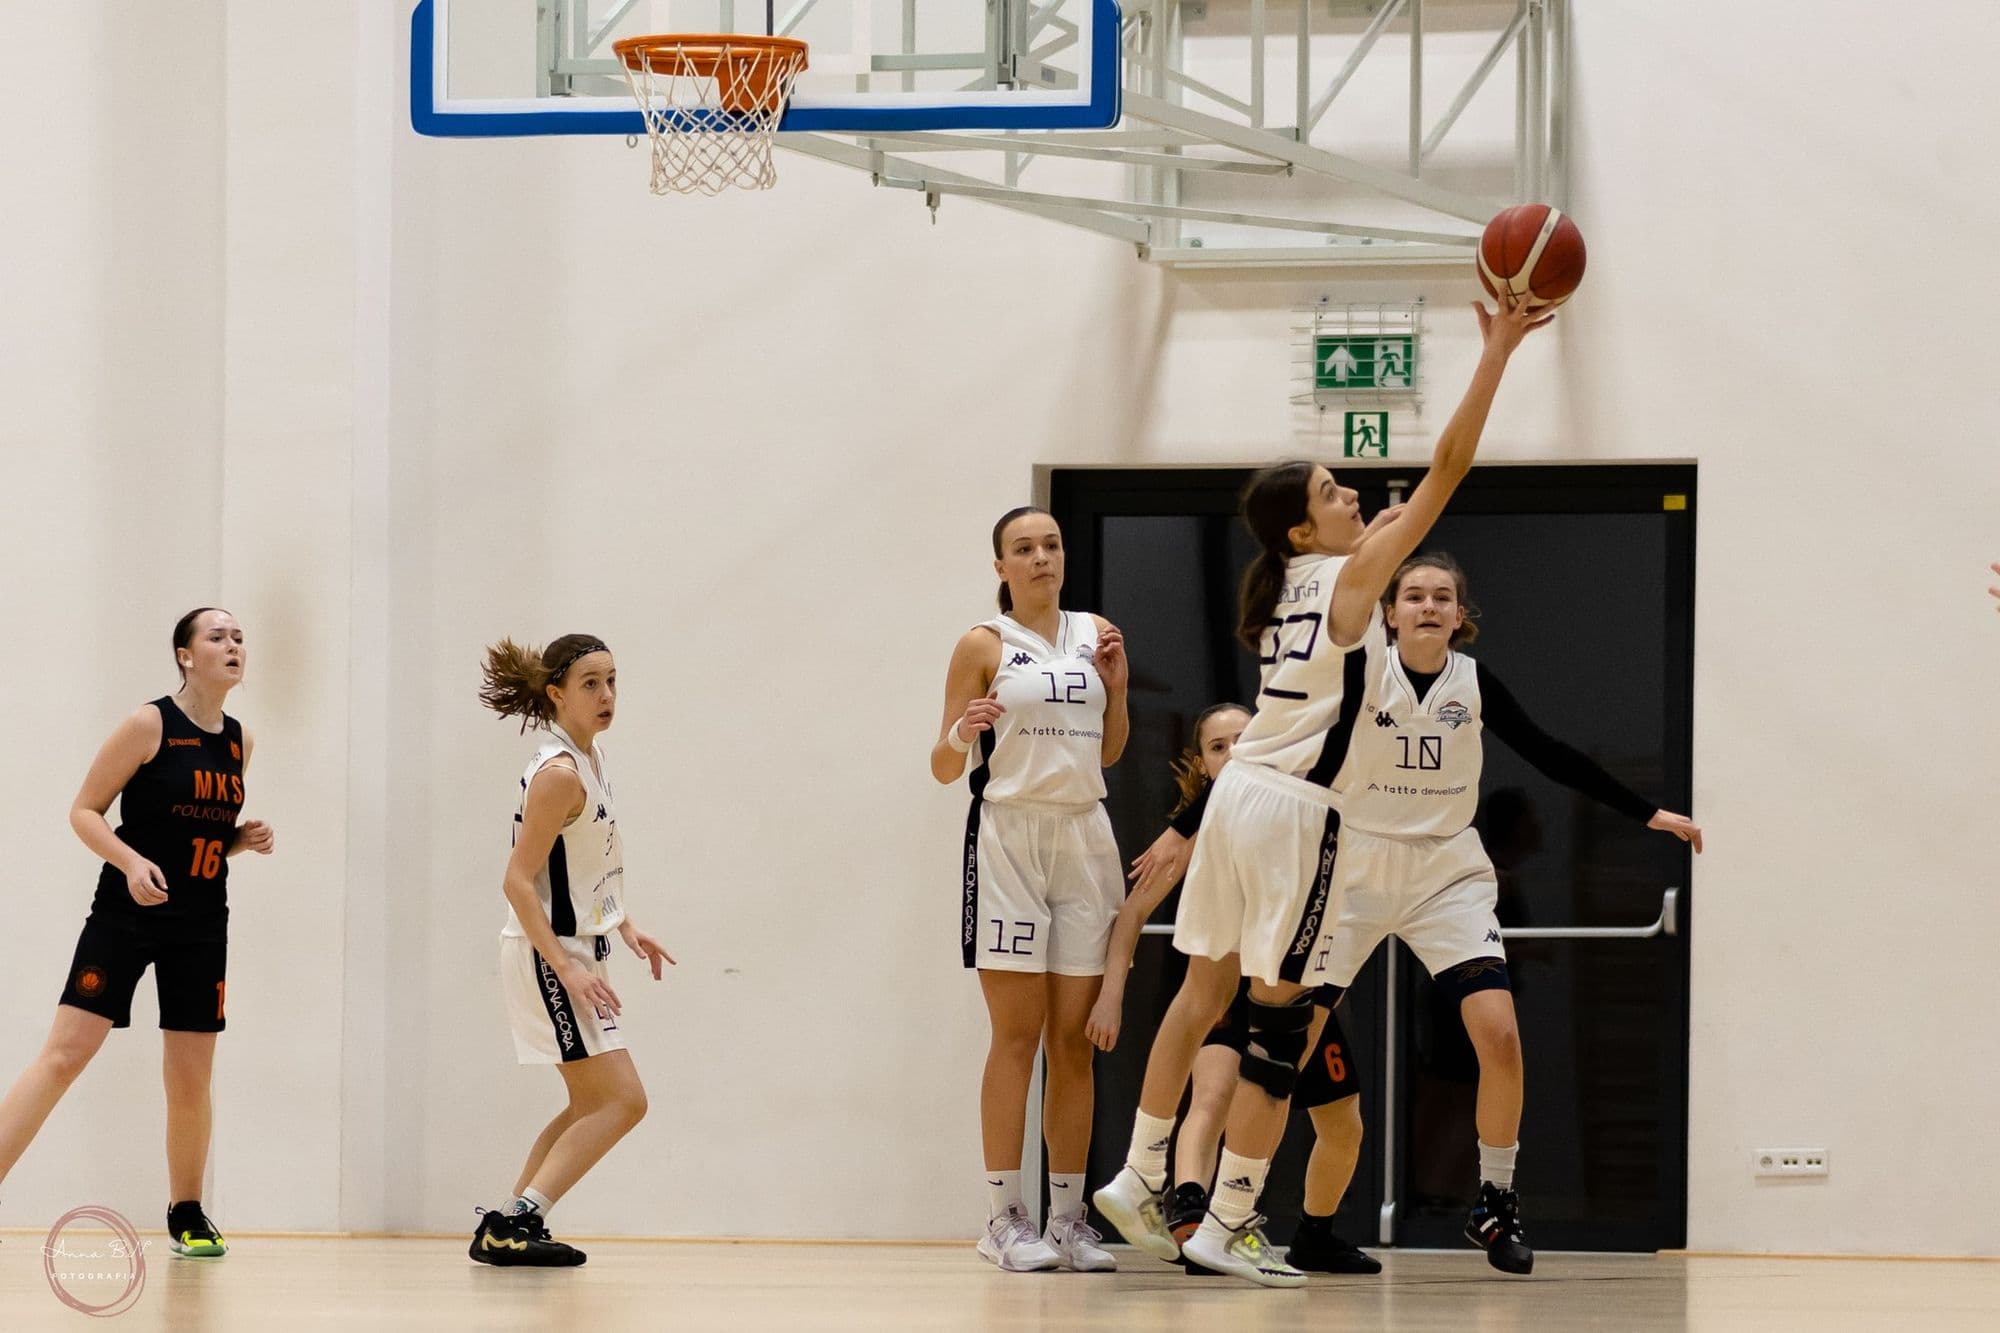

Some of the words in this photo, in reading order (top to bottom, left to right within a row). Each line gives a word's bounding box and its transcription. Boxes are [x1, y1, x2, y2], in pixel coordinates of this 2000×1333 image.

[1041, 672, 1087, 704] 12
[1033, 727, 1064, 736] fatto
[1395, 736, 1442, 770] 10
[194, 769, 243, 804] MKS
[190, 838, 222, 879] 16
[988, 919, 1035, 955] 12
[1325, 1043, 1345, 1082] 6
